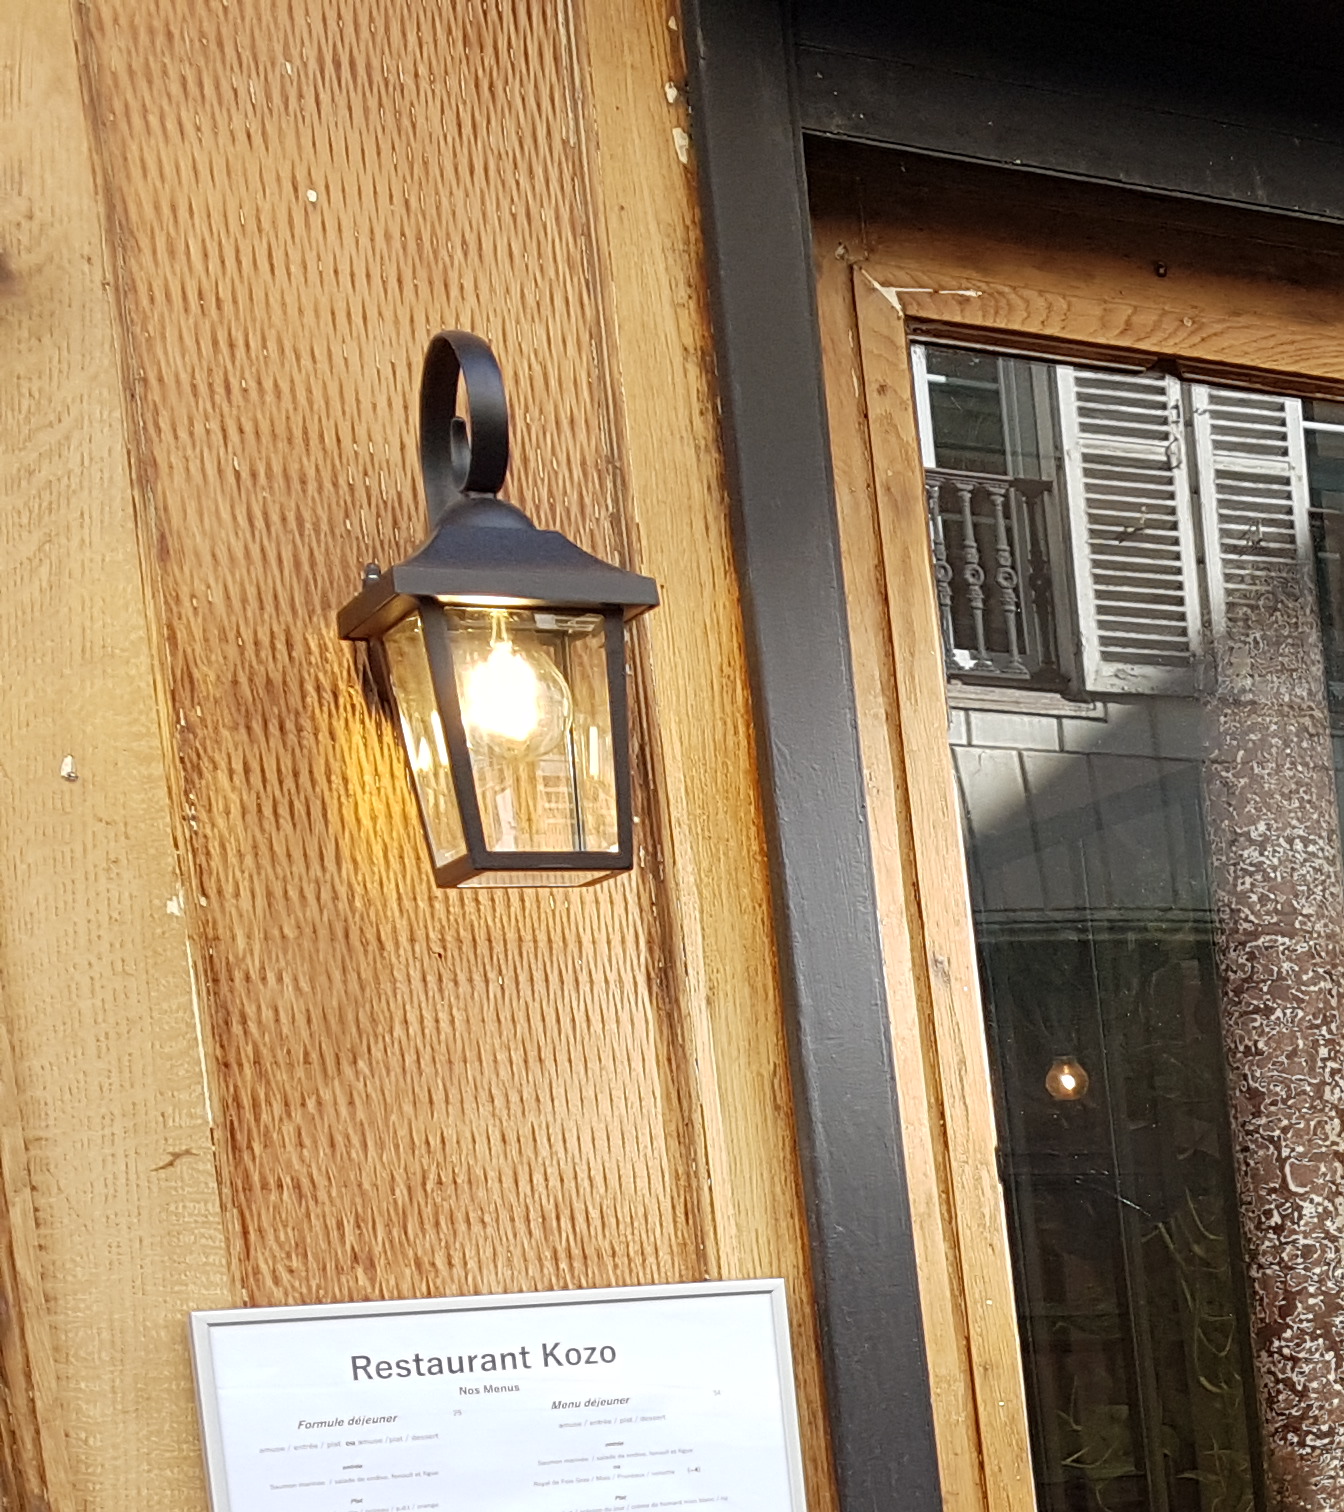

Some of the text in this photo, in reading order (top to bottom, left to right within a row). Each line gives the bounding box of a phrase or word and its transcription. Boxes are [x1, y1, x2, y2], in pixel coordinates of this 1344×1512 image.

[351, 1342, 617, 1381] Restaurant Kozo
[459, 1383, 520, 1395] Nos Menus
[551, 1400, 581, 1410] Menu
[584, 1397, 630, 1408] déjeuner
[297, 1417, 344, 1429] Formule
[348, 1414, 398, 1426] déjeuner
